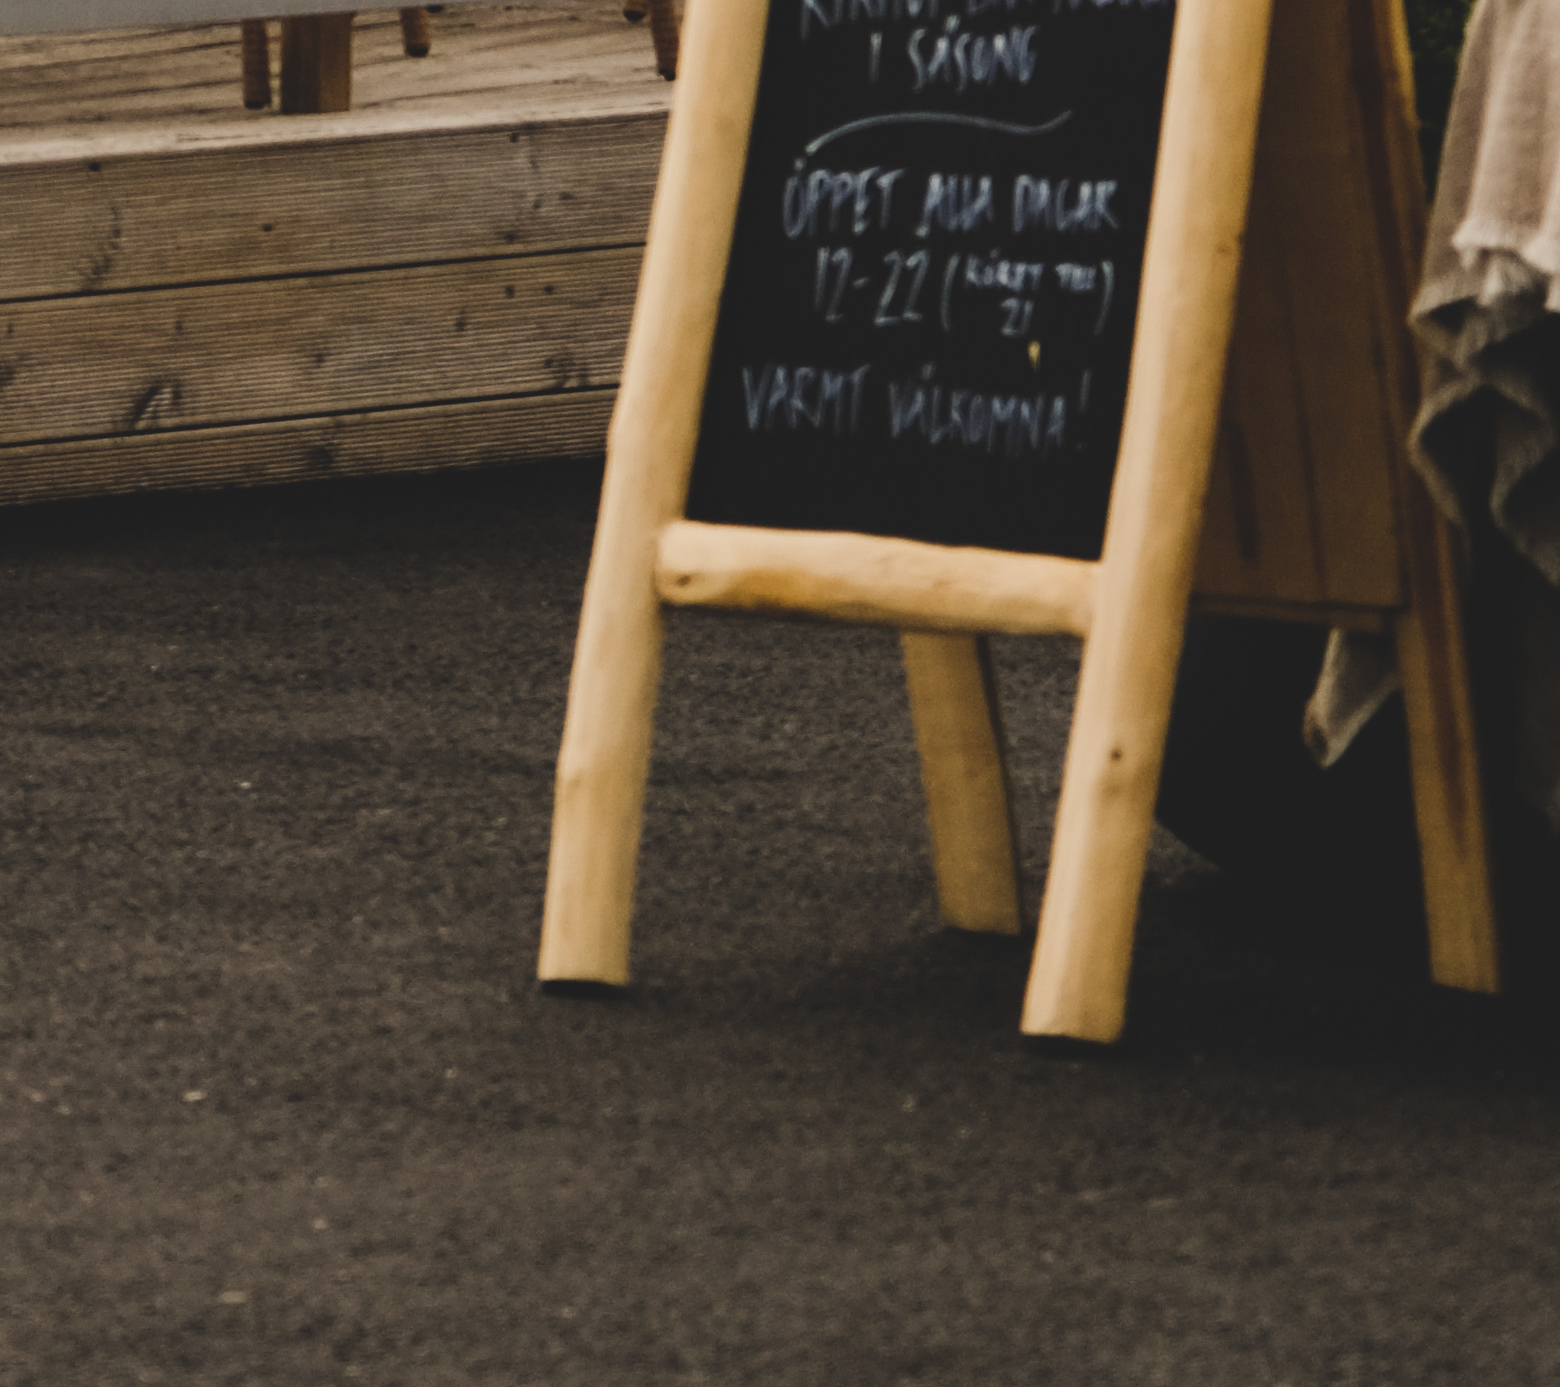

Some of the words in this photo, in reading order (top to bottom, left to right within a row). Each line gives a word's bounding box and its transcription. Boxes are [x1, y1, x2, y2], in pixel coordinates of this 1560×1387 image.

[905, 14, 1039, 95] SÄSONG
[781, 156, 907, 240] ÖPPET
[914, 171, 994, 238] ALLA
[1011, 172, 1119, 235] DAGAR
[741, 360, 870, 434] VARMT
